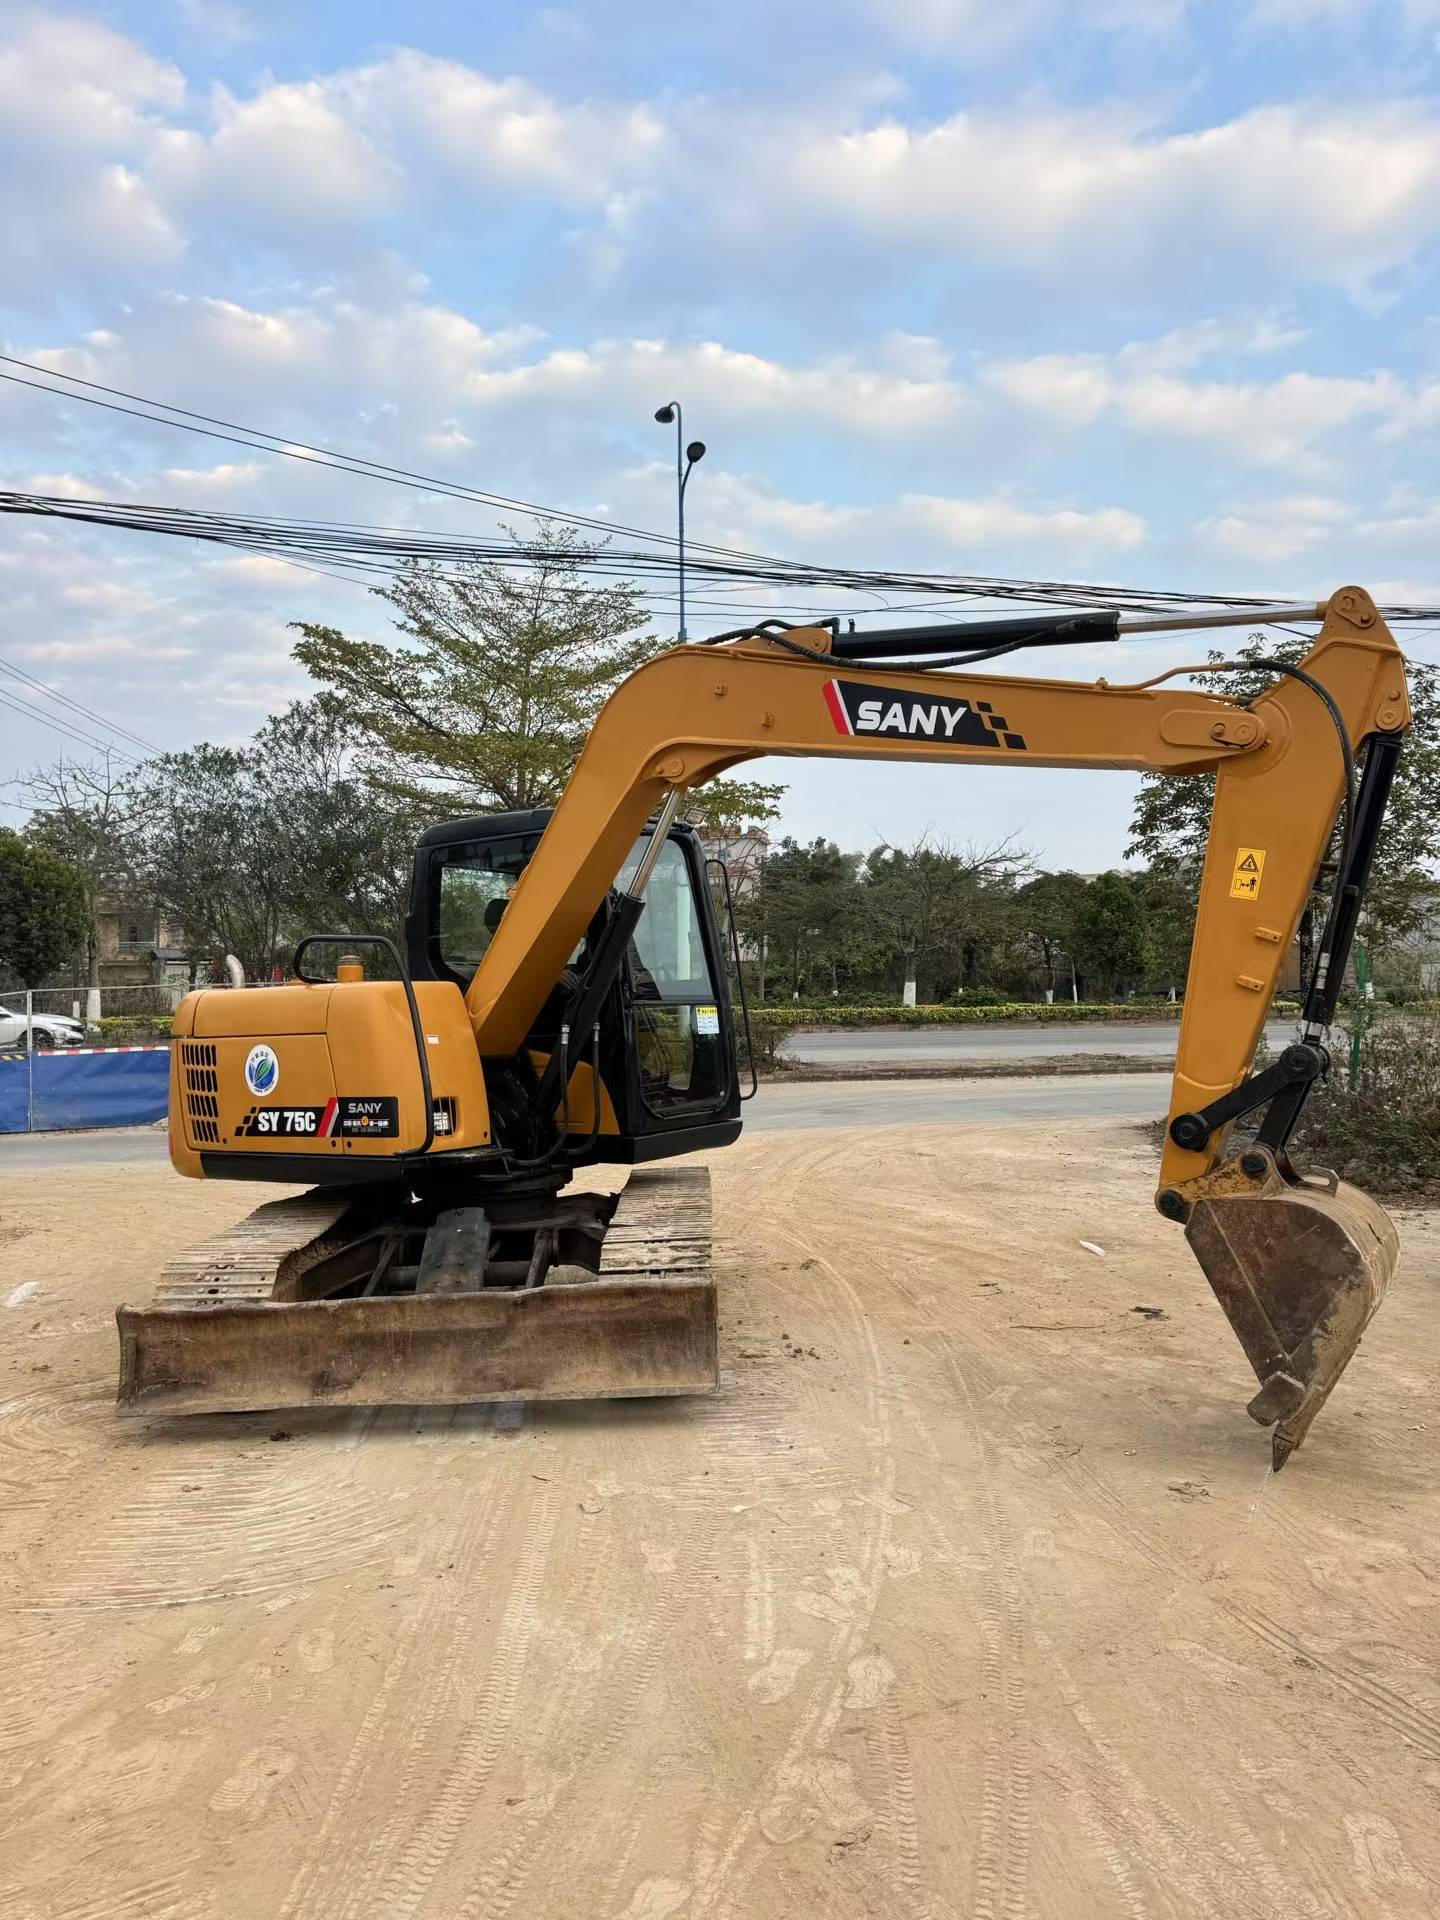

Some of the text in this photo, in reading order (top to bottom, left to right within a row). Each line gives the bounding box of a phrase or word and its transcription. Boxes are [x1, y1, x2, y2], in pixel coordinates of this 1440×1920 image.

[855, 700, 968, 737] SANY
[348, 1102, 383, 1114] SANY
[257, 1111, 316, 1132] SY 75C
